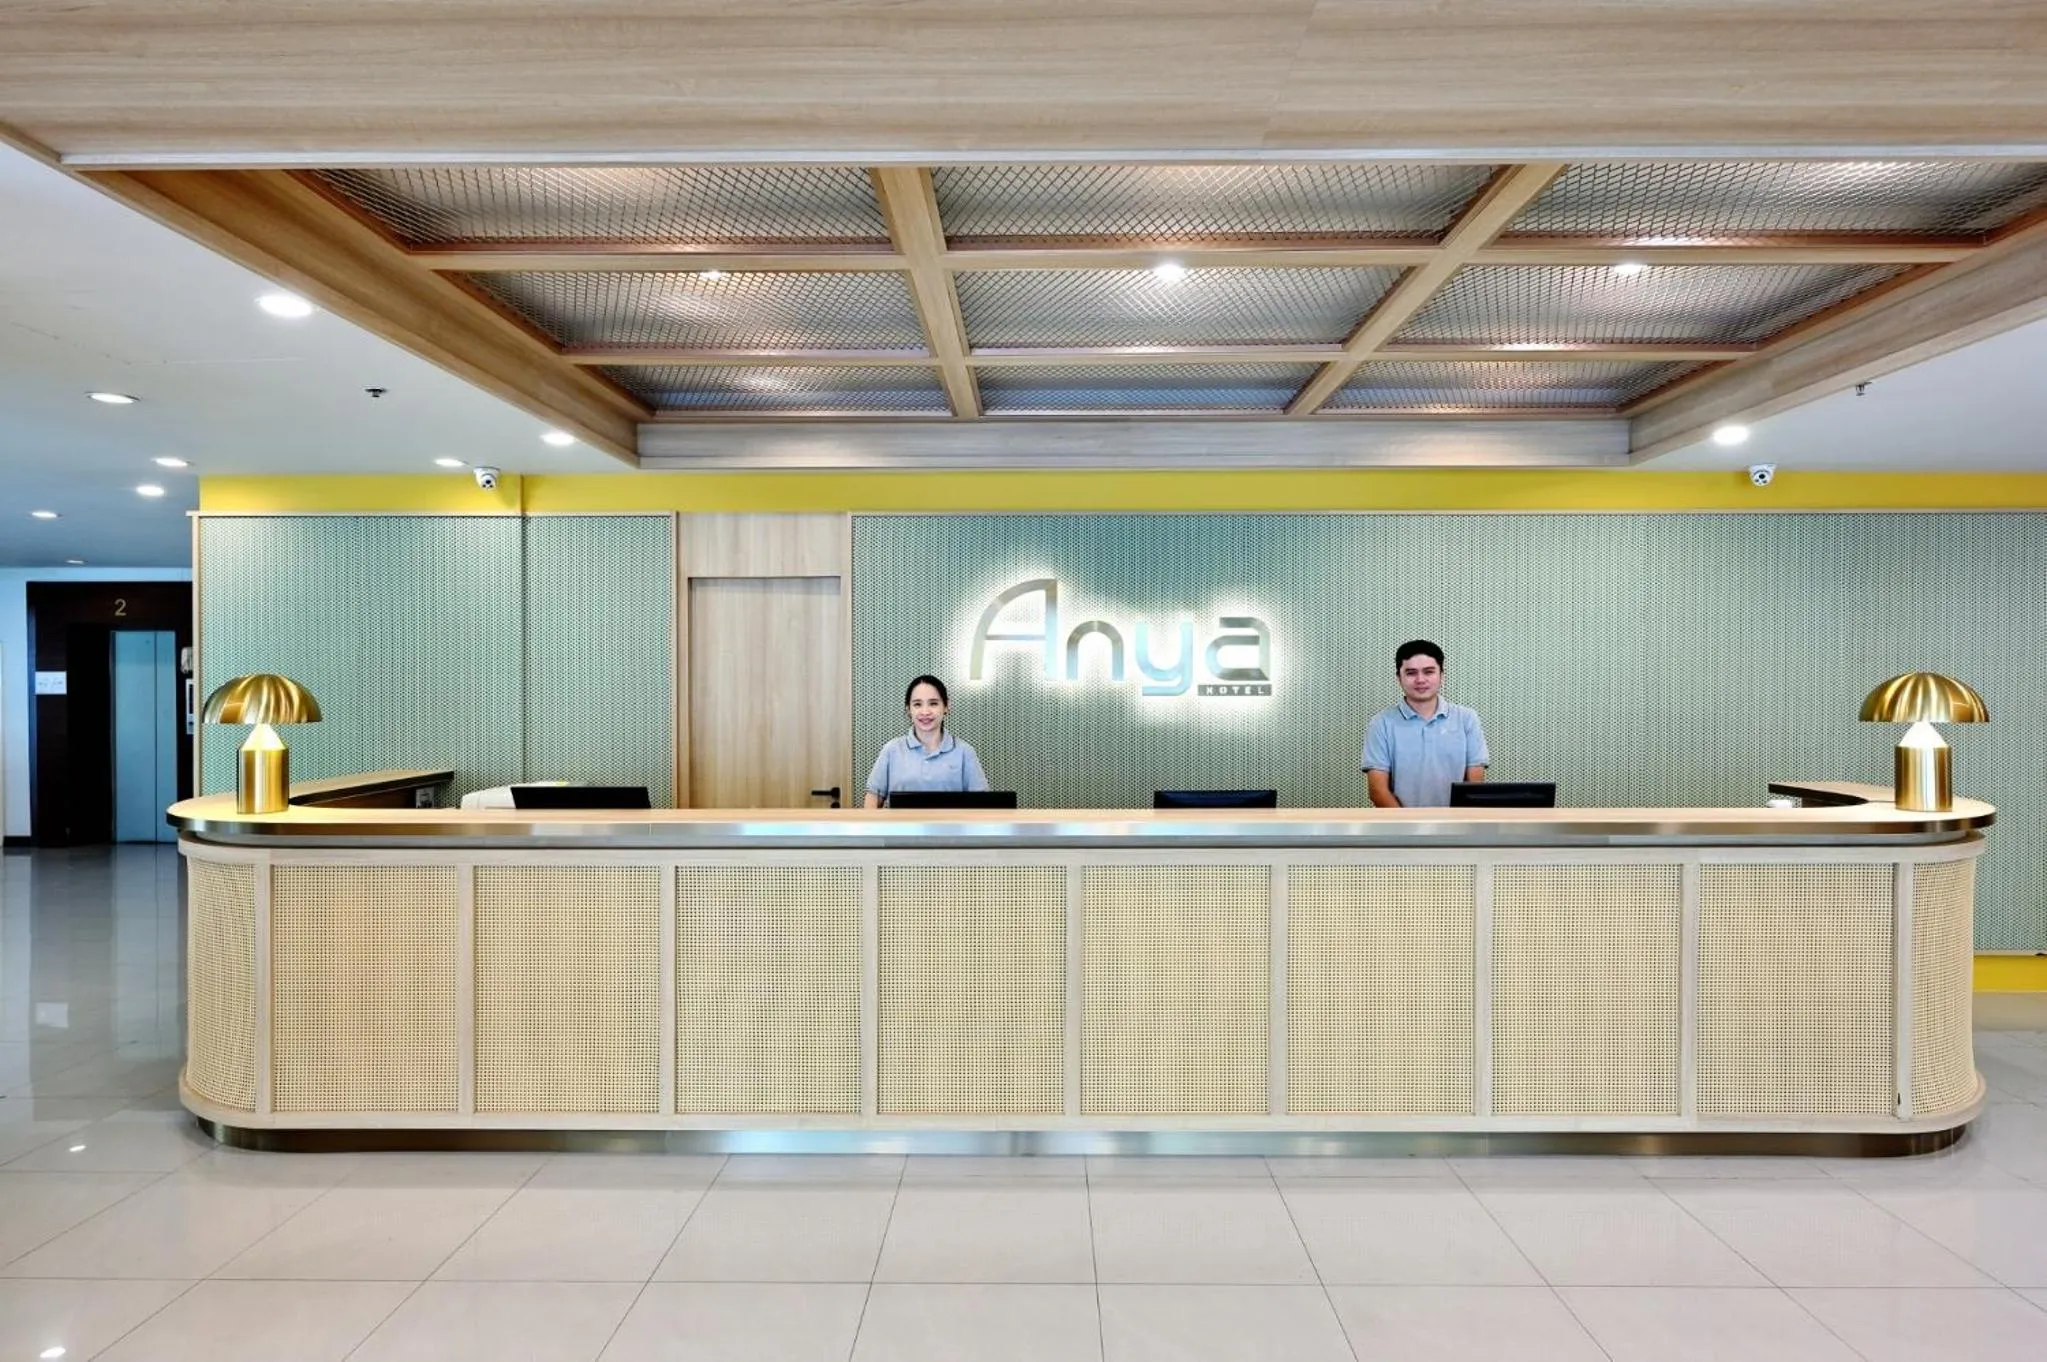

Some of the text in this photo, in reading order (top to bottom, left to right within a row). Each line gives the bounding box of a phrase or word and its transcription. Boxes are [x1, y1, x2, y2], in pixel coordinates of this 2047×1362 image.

[114, 598, 127, 616] 2
[969, 577, 1271, 697] Anya
[1205, 685, 1266, 695] HOTEL
